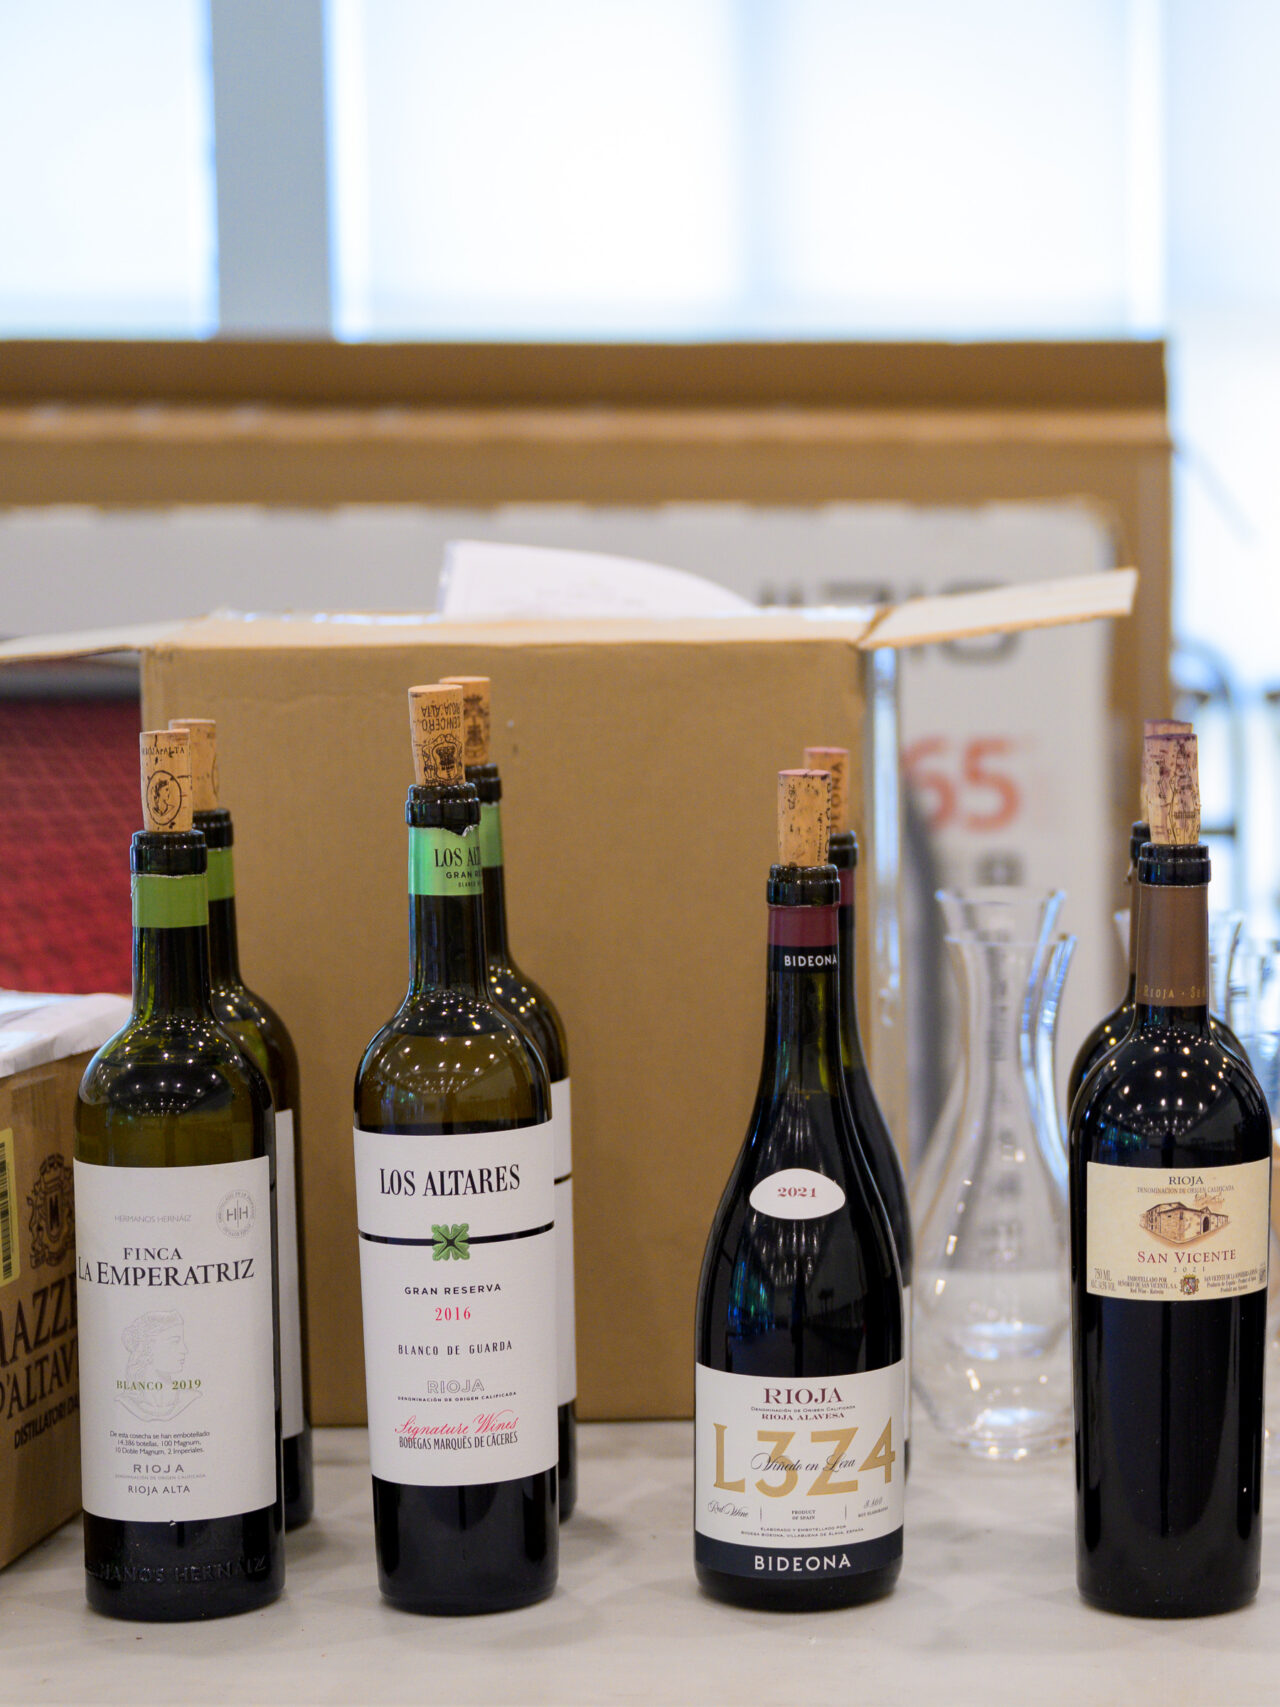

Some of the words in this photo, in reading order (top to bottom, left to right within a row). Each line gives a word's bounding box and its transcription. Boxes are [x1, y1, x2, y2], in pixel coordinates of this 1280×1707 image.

[434, 848, 463, 867] LOS
[446, 871, 472, 879] GRAN
[784, 953, 838, 967] BIDEONA
[1143, 984, 1175, 1001] RIOJA
[380, 1168, 416, 1197] LOS
[422, 1163, 521, 1197] ALTARES
[1168, 1176, 1204, 1187] RIOJA
[777, 1186, 817, 1198] 2021
[114, 1215, 155, 1223] HERMANOS
[123, 1247, 183, 1261] FINCA
[1137, 1251, 1168, 1264] SAN
[1175, 1249, 1236, 1264] VICENTE
[78, 1256, 92, 1282] LA
[96, 1258, 255, 1287] EMPERATRIZ
[404, 1286, 438, 1295] GRAN
[444, 1283, 502, 1295] RESERVA
[435, 1306, 471, 1321] 2016
[398, 1344, 439, 1356] BLANCO
[447, 1345, 460, 1356] DE
[469, 1340, 513, 1355] GUARDA
[116, 1380, 163, 1390] BLANCO
[172, 1379, 201, 1390] 2019
[427, 1379, 485, 1394] RIOJA
[481, 1391, 517, 1400] CALIFICADA
[763, 1387, 842, 1404] RIOJA
[761, 1413, 794, 1421] RIOJA
[797, 1412, 845, 1421] ALAVESA
[395, 1415, 469, 1442] Signature
[472, 1409, 519, 1434] Wines
[399, 1436, 432, 1450] BODEGAS
[433, 1436, 472, 1450] MARQUÉS
[474, 1436, 484, 1448] DE
[486, 1430, 519, 1447] CÁCERES
[713, 1416, 896, 1498] L3Z4
[750, 1452, 803, 1472] Viñedo
[805, 1461, 818, 1471] en
[823, 1452, 856, 1472] Leza
[133, 1464, 184, 1474] RIOJA
[128, 1485, 158, 1496] RIOJA
[162, 1485, 191, 1494] ALTA
[708, 1500, 724, 1513] Red
[723, 1502, 750, 1518] Wine
[754, 1553, 851, 1571] BIDEONA
